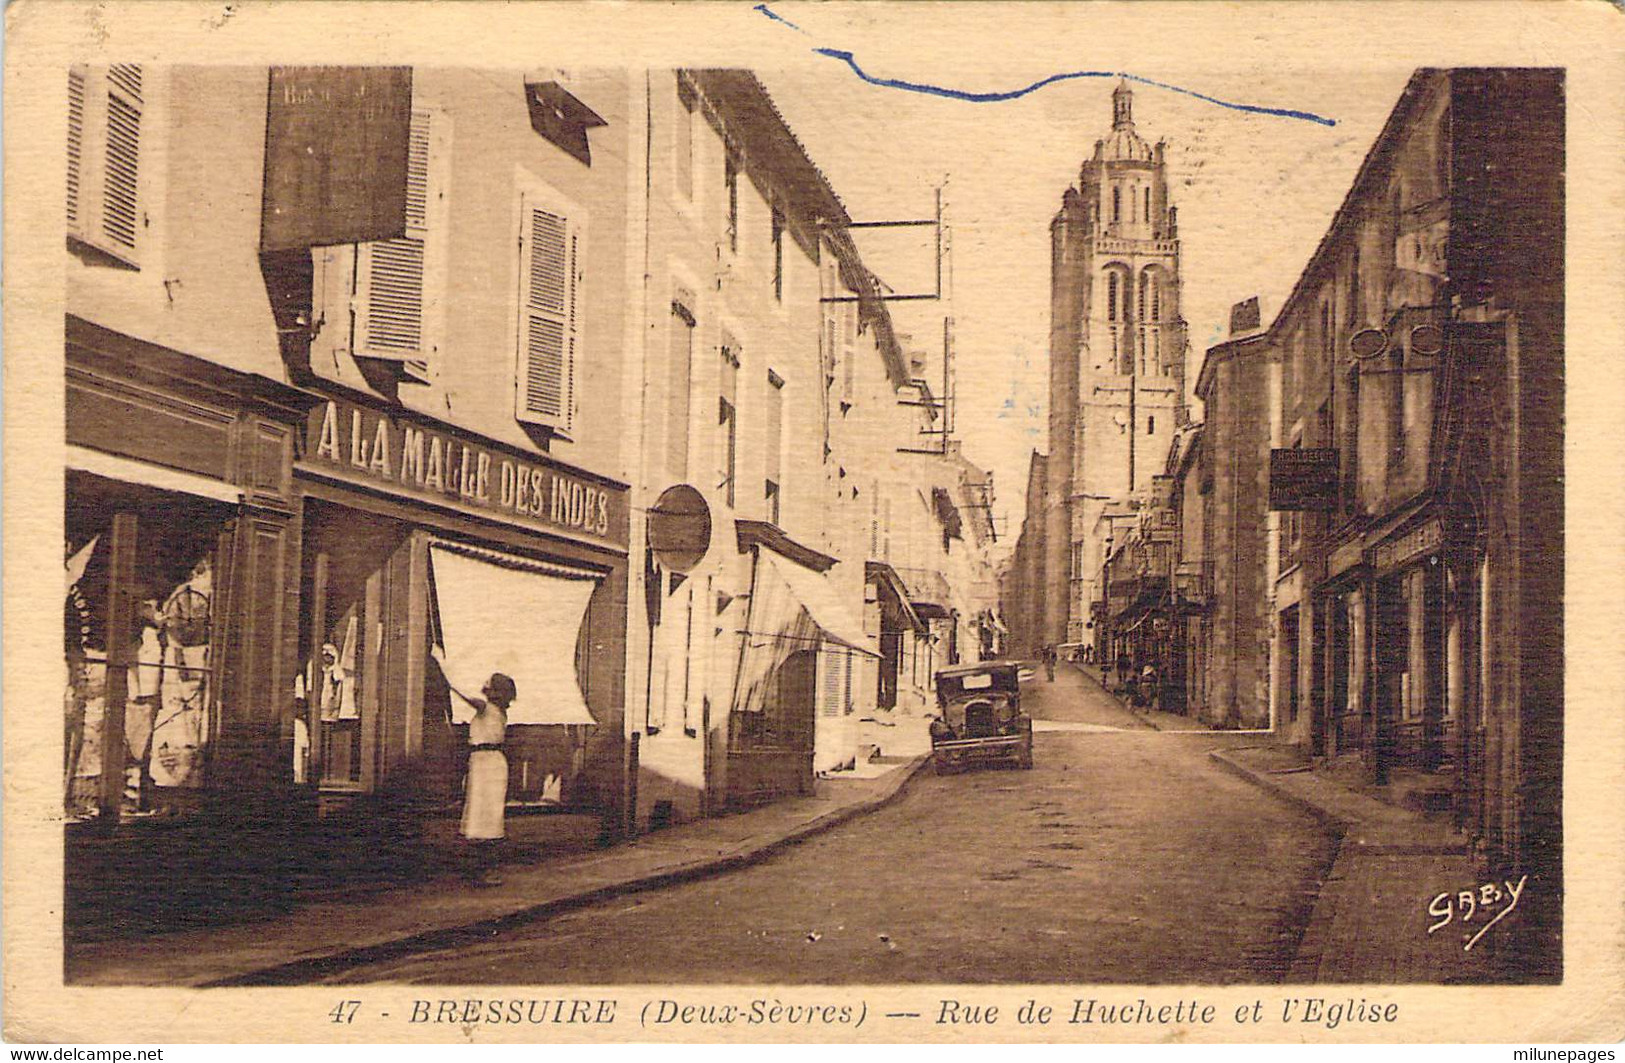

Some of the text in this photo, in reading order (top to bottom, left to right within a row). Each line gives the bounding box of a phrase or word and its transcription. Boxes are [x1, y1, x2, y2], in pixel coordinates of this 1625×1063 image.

[318, 400, 609, 537] A LA MALLE DES INDES
